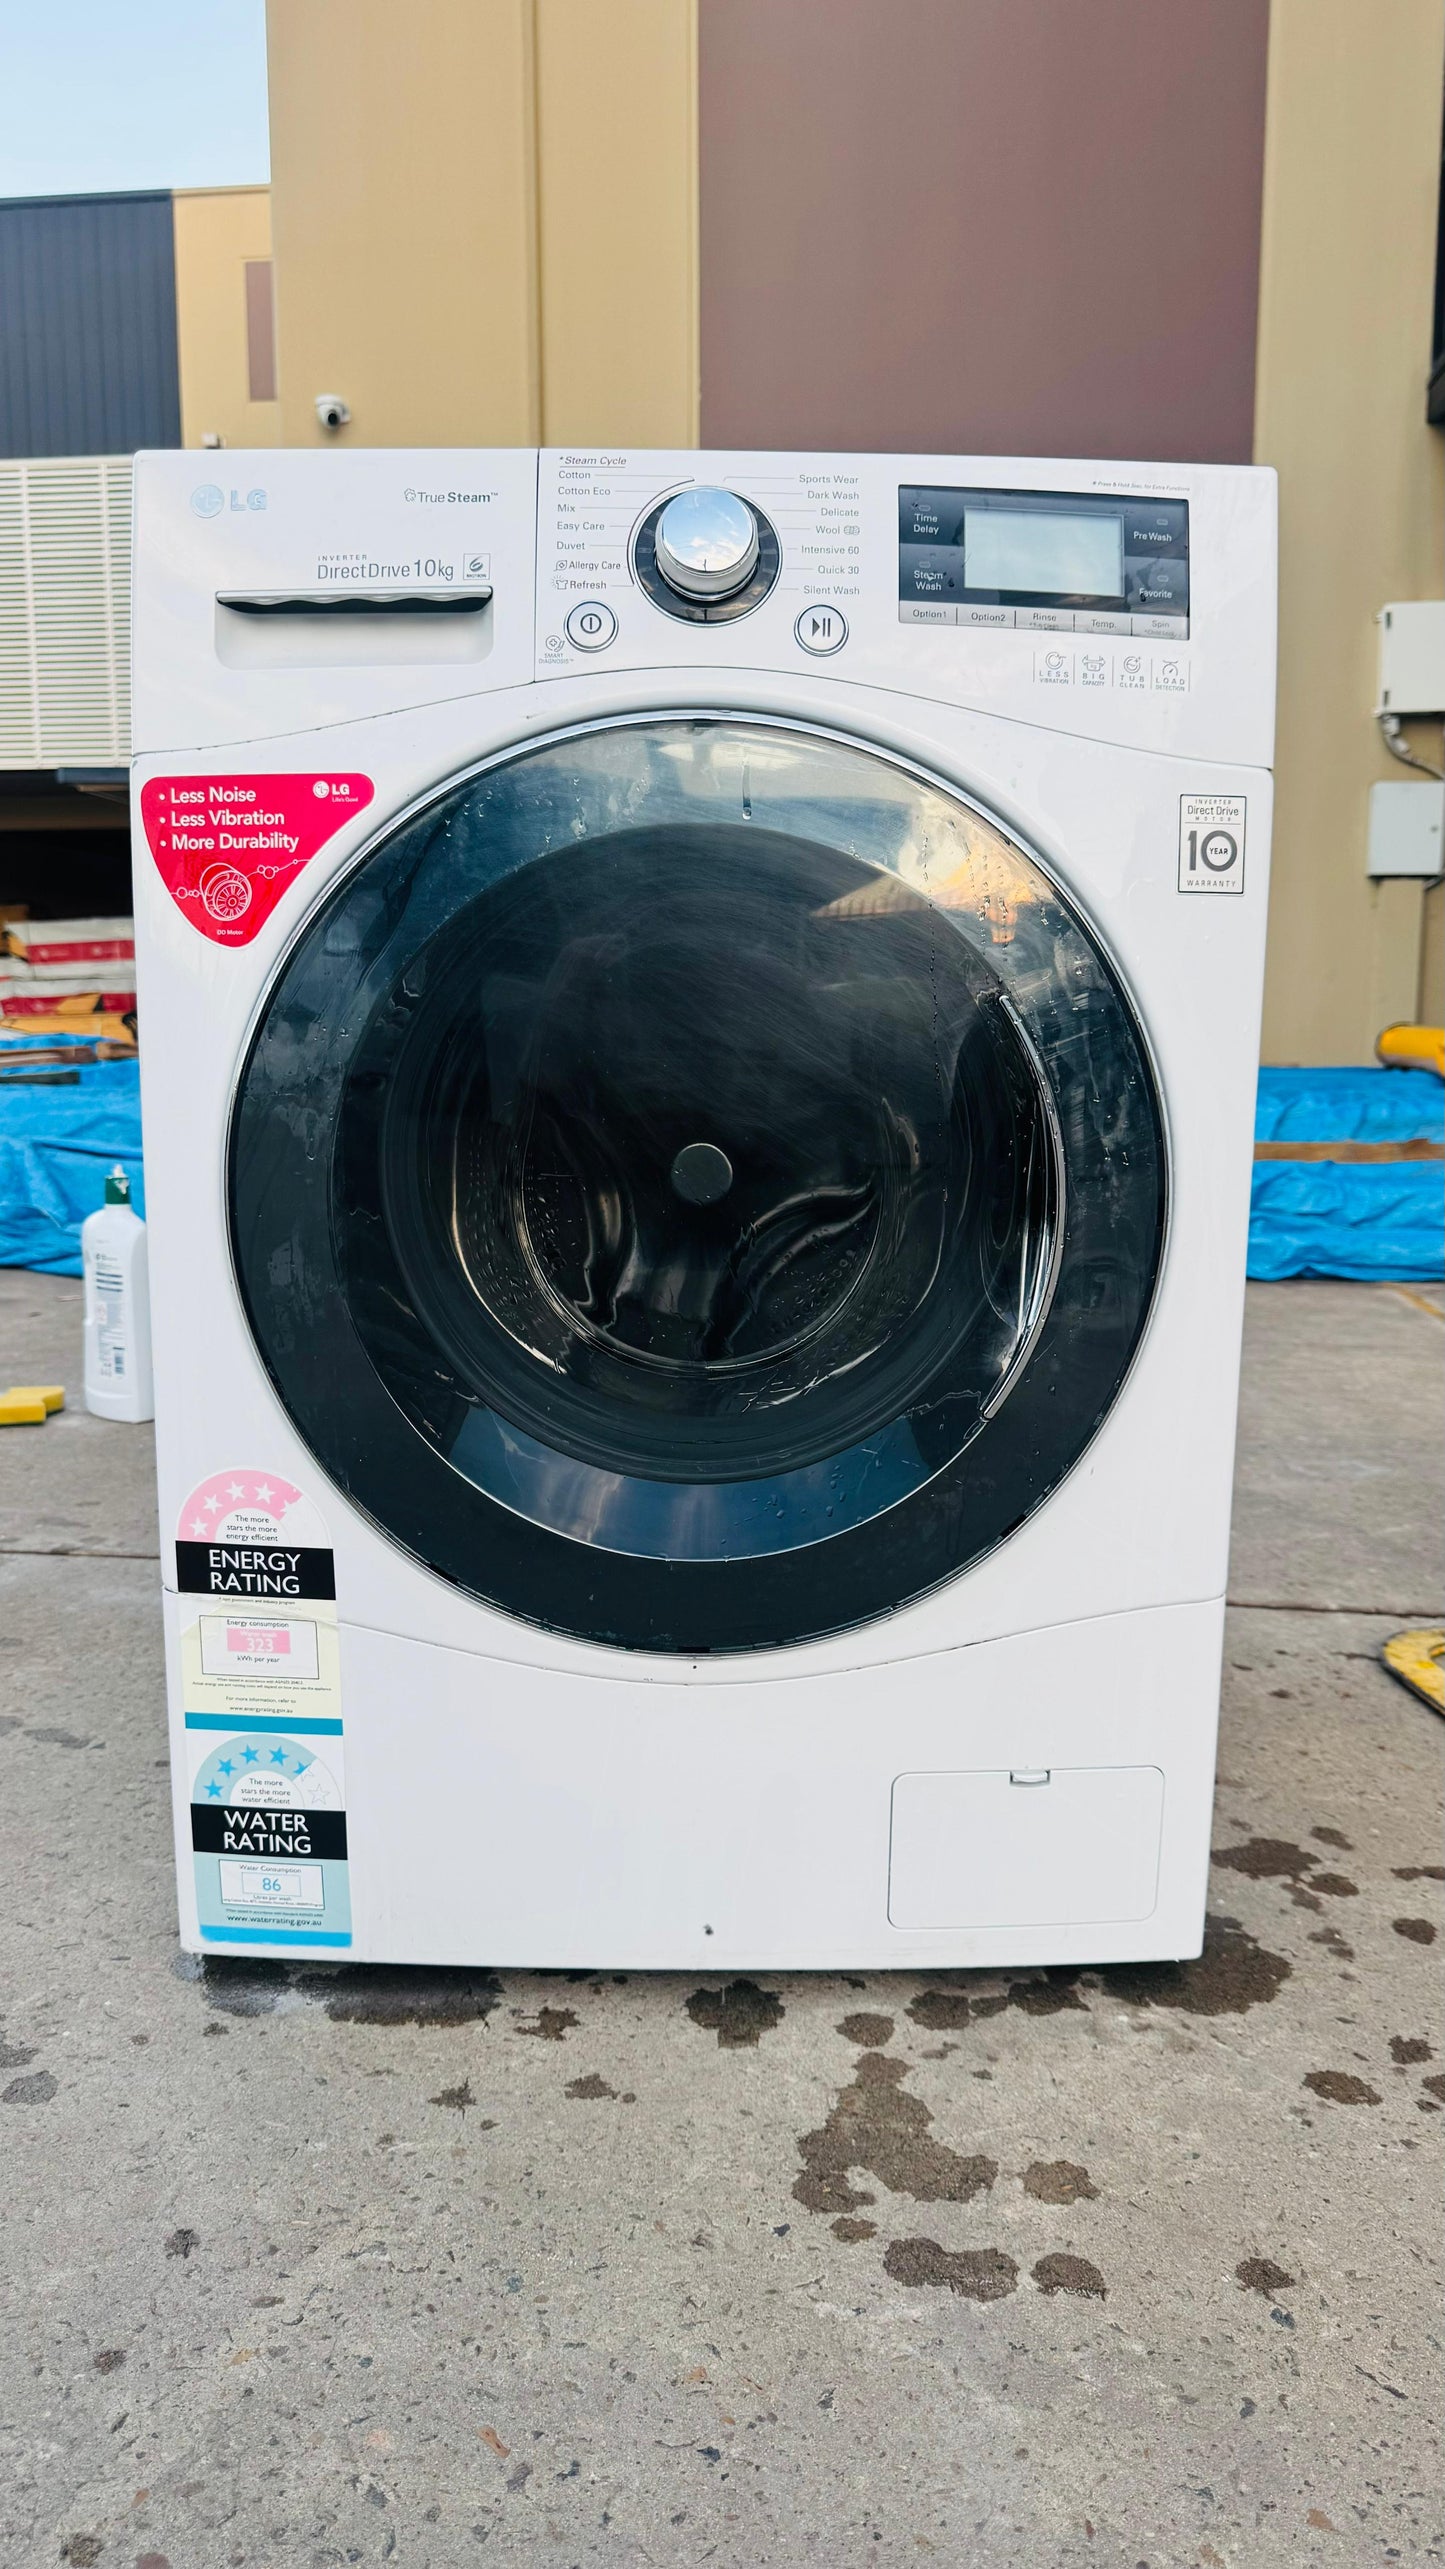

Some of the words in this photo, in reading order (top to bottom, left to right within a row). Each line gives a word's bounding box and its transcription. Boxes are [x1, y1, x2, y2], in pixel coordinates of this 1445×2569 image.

[600, 457, 626, 466] Cycle
[559, 471, 591, 479] Cotton
[799, 475, 830, 484] Sports
[834, 476, 858, 484] Wear
[558, 487, 589, 495] Cotton
[593, 487, 610, 495] Eco
[808, 491, 830, 499] Dark
[834, 491, 859, 500] Wash
[231, 489, 266, 511] LG
[558, 504, 576, 512] Mix
[821, 508, 859, 517] Delicate
[914, 513, 938, 522] Time
[557, 522, 580, 531] Easy
[584, 522, 605, 531] Care
[816, 526, 840, 535] Wool
[914, 525, 939, 535] Delay
[1134, 531, 1147, 540] Pre
[1148, 533, 1172, 542] Wash
[557, 541, 585, 550] Duvet
[801, 546, 845, 554] Intensive
[848, 546, 859, 554] 60
[414, 559, 454, 581] 10kg
[569, 561, 597, 571] Allergy
[601, 562, 621, 570] Care
[818, 566, 845, 575] Quick
[848, 566, 859, 574] 30
[570, 581, 606, 589] Refresh
[916, 582, 941, 591] Wash
[804, 586, 830, 594] Silent
[834, 586, 860, 595] Wash
[1139, 588, 1172, 598] Favorite
[912, 609, 947, 619] Option1
[971, 612, 1006, 622] Option2
[1033, 613, 1057, 622] Rinse
[1091, 619, 1117, 629] Temp.
[1152, 620, 1169, 628] Spin
[1039, 670, 1069, 678] LESS
[332, 784, 349, 795] LG
[171, 788, 205, 804] Less
[209, 787, 256, 803] Noise
[1188, 805, 1214, 815] Direct
[1216, 807, 1239, 816] Drive
[171, 812, 205, 826] Less
[209, 810, 284, 825] Vibration
[172, 836, 214, 849] More
[219, 833, 299, 852] Durability
[1188, 830, 1237, 872] 10
[251, 1534, 278, 1542] efficient
[209, 1550, 301, 1571] ENERGY
[210, 1572, 300, 1593] RATING
[227, 1619, 247, 1627] Energy
[247, 1638, 274, 1652] 323
[223, 1810, 309, 1833] WATER
[223, 1832, 312, 1854] RATING
[260, 1865, 301, 1874] Consumption
[262, 1878, 281, 1891] 86
[227, 1915, 322, 1926] www.waterrating.gov.au
